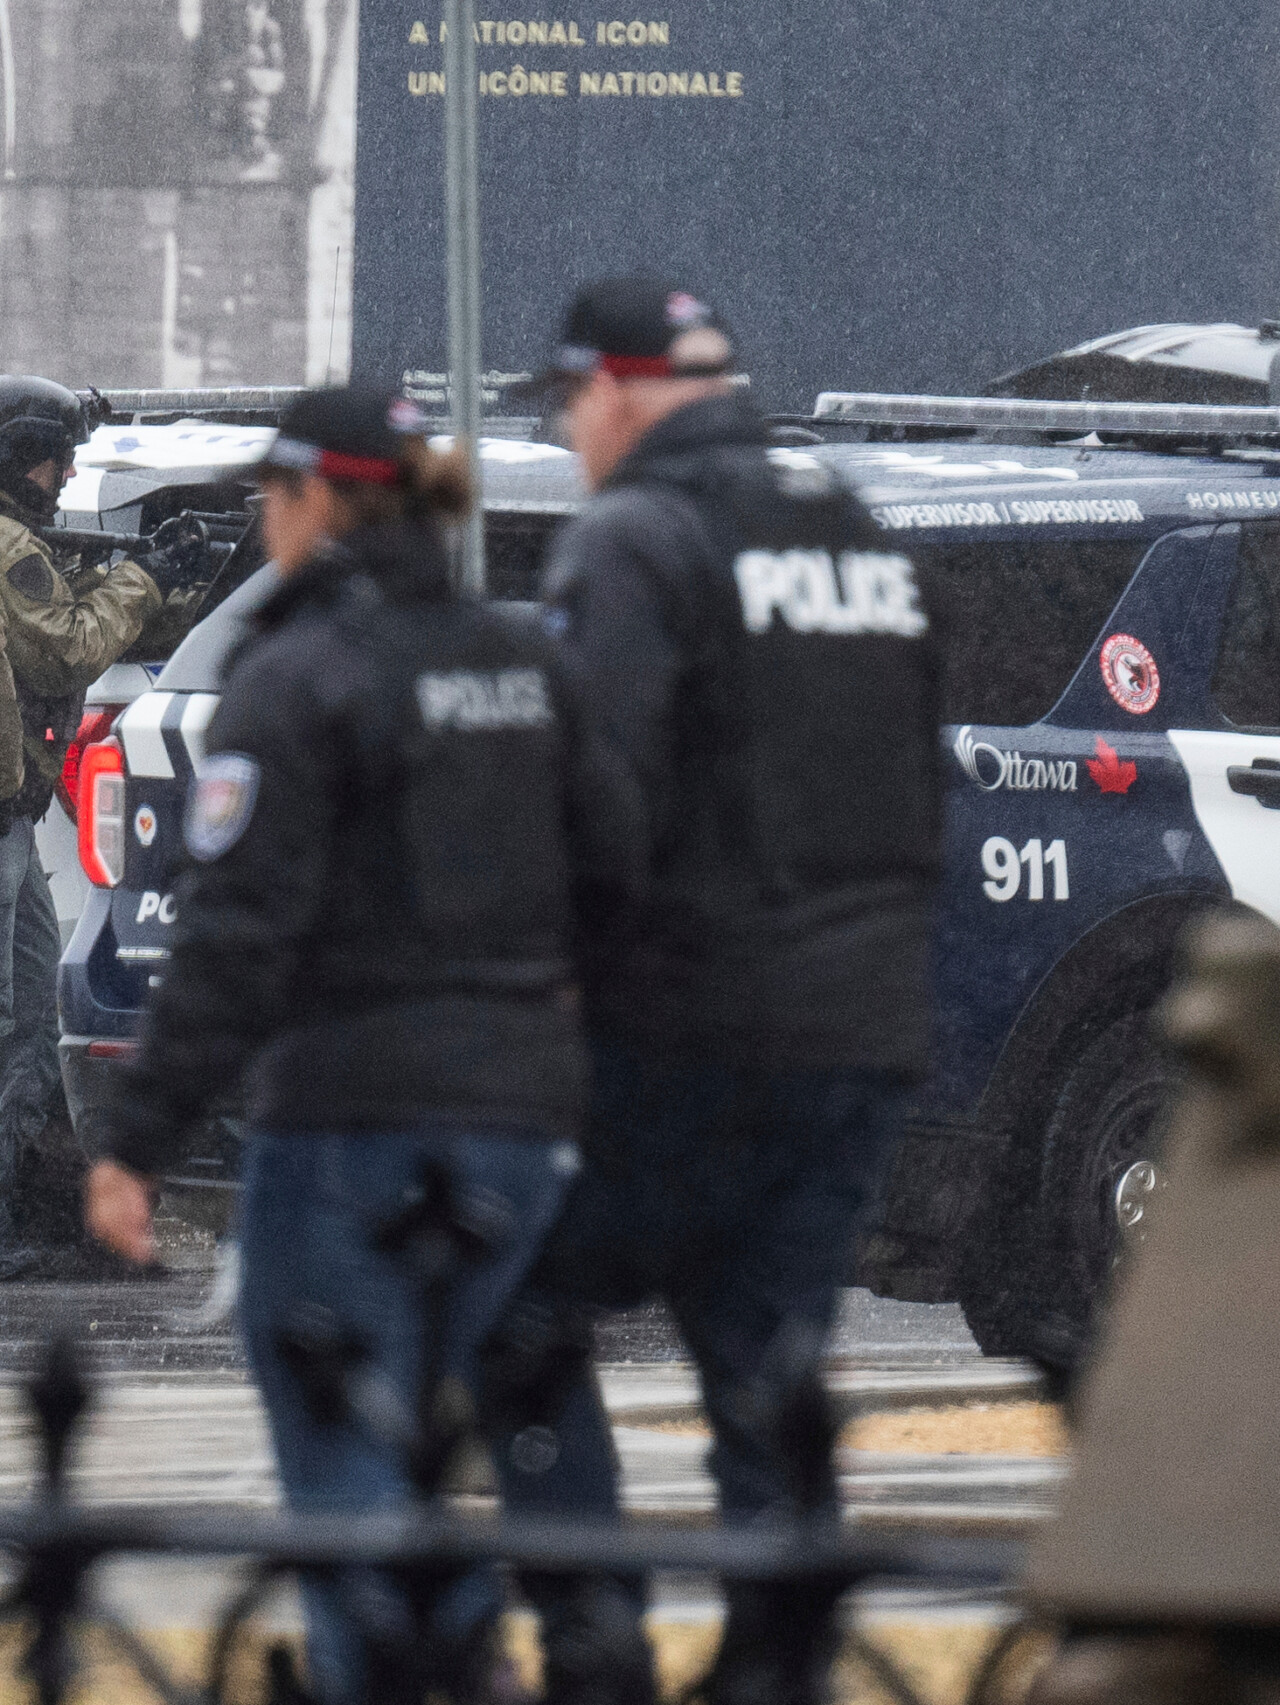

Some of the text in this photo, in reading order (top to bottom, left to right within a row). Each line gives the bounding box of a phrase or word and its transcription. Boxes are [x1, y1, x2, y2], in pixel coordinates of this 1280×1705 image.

[408, 21, 429, 45] A
[596, 21, 670, 46] ICON
[408, 64, 744, 97] UN ICÔNE NATIONALE
[871, 502, 1002, 529] SUPERVISOR
[1010, 499, 1145, 525] SUPERVISEUR
[1185, 490, 1280, 511] HONNEU
[735, 549, 927, 635] POLICE
[956, 727, 1078, 792] Ottawa
[981, 836, 1070, 902] 911
